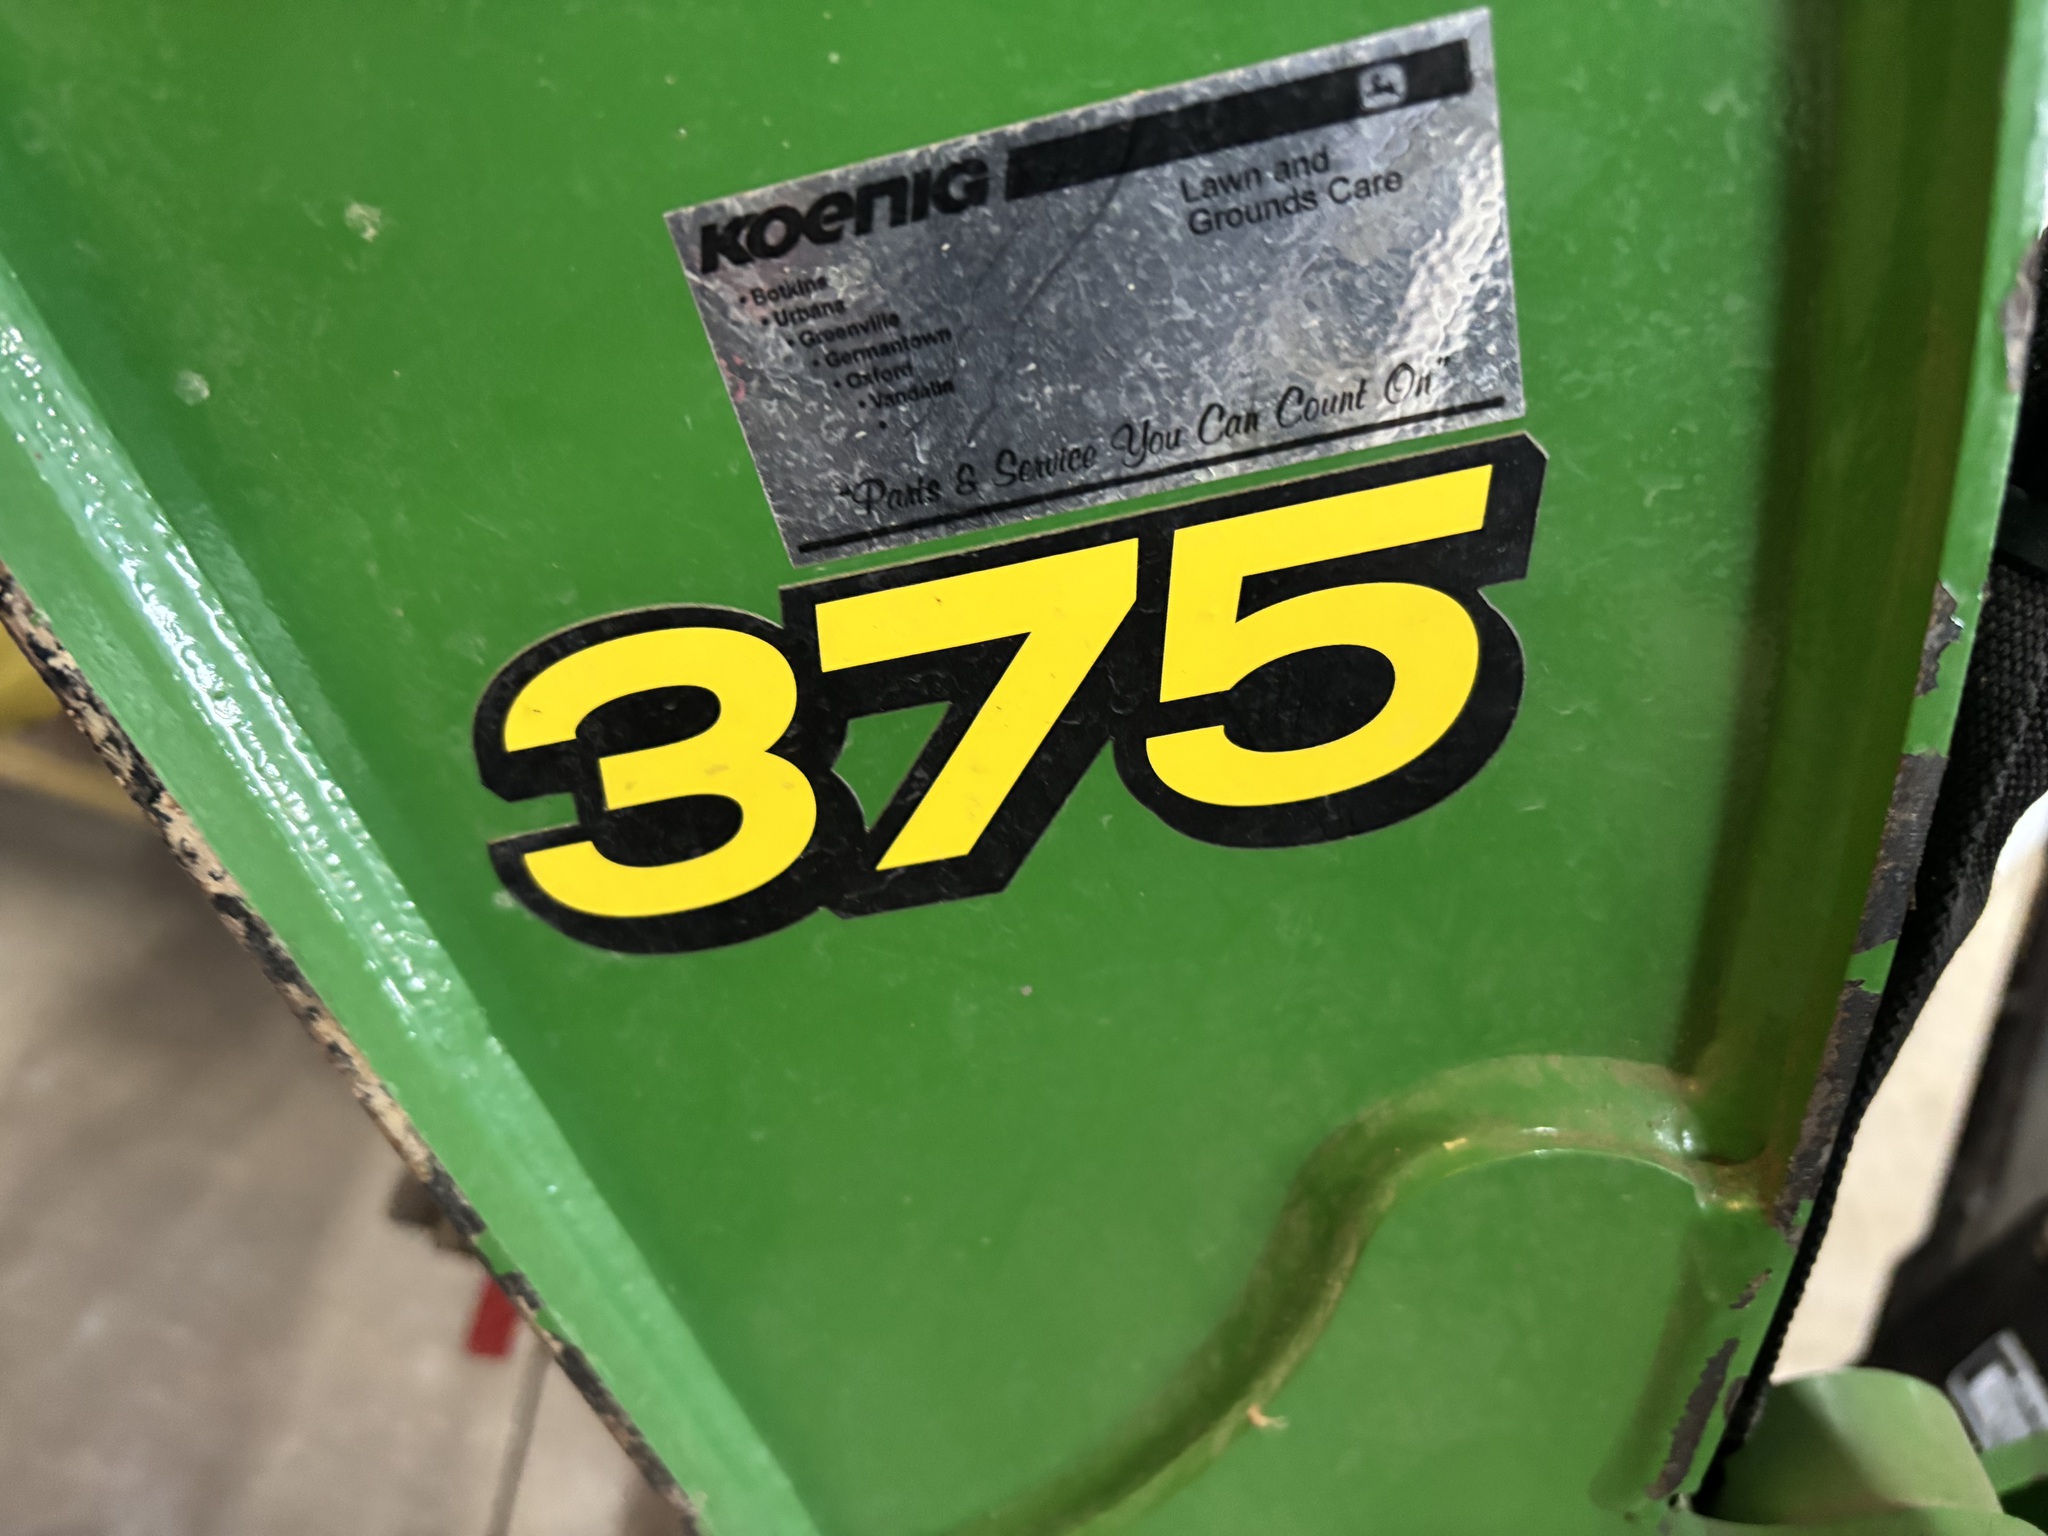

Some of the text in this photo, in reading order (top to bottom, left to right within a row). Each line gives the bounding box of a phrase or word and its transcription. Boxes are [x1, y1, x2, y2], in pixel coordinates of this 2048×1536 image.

[1179, 143, 1330, 204] Lawn and
[1187, 169, 1404, 236] Grounds Care
[750, 274, 829, 306] Botkins
[772, 298, 847, 328] Urbana
[798, 310, 901, 348] Greenville
[823, 326, 954, 370] Germantown
[845, 361, 915, 390] Oxford
[955, 462, 979, 497] &
[992, 448, 1097, 488] Service
[1110, 419, 1181, 468] You
[1199, 402, 1260, 446] Can
[1276, 377, 1367, 428] Count
[504, 463, 1493, 918] 375
